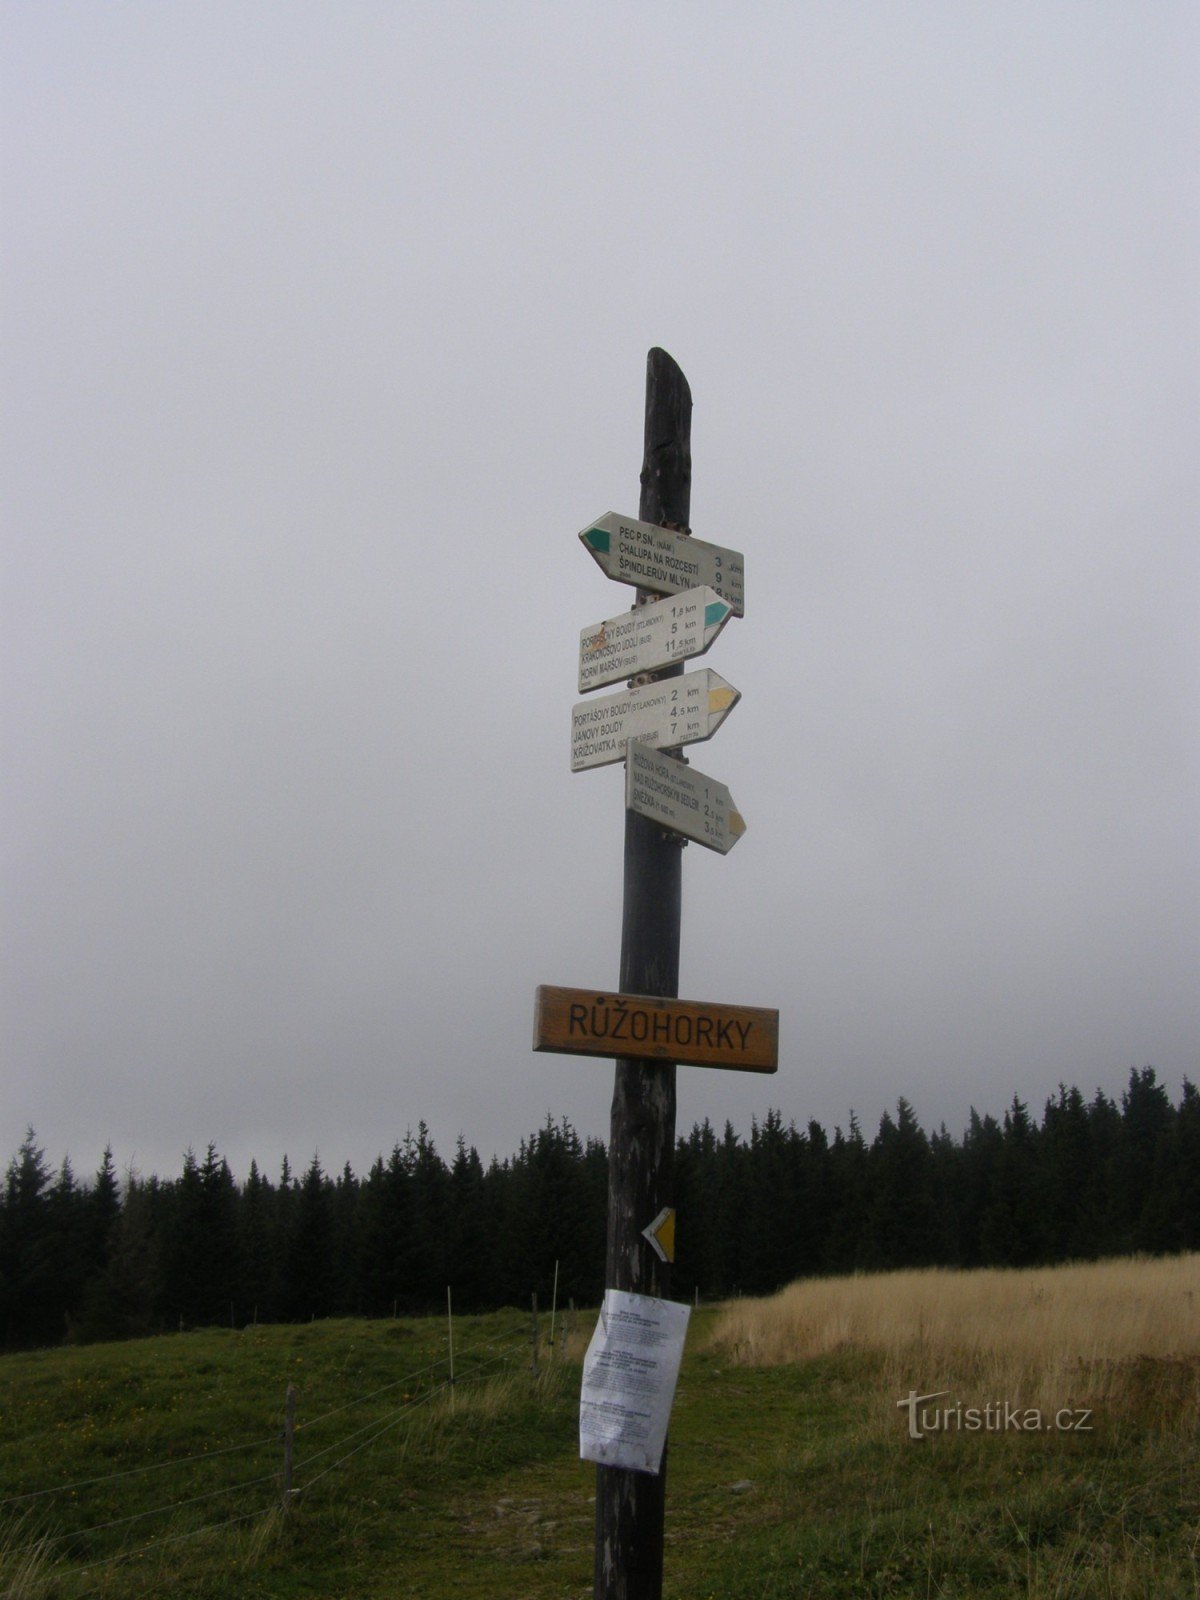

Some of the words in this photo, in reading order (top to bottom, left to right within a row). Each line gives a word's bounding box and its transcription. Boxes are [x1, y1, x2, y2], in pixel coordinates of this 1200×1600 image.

[619, 526, 635, 541] PEC
[619, 543, 652, 562] CHALUPA
[653, 553, 664, 565] NA
[664, 556, 699, 576] ROZCESTÍ
[715, 557, 722, 567] 3
[730, 563, 742, 574] km
[619, 556, 668, 582] ŠPINDLERŮV
[669, 572, 690, 589] MLÝN
[715, 572, 722, 583] 9
[731, 580, 742, 589] km
[685, 604, 697, 614] km
[615, 621, 636, 637] BOUDY
[671, 622, 678, 634] 5
[685, 620, 697, 629] km
[684, 636, 697, 646] km
[580, 662, 599, 681] HORNÍ
[599, 656, 623, 674] MARŠOV
[671, 689, 678, 701] 2
[687, 687, 699, 697] km
[574, 705, 611, 727] PORTÁŠOVY
[610, 700, 632, 717] BOUDY
[686, 704, 699, 714] km
[573, 725, 600, 743] JANOVY
[600, 720, 624, 736] BOUDY
[670, 723, 677, 734] 7
[687, 721, 699, 731] km
[573, 738, 616, 759] KŘIŽOVATKA
[704, 788, 709, 799] 1
[569, 997, 752, 1051] RŮŽOHORKY
